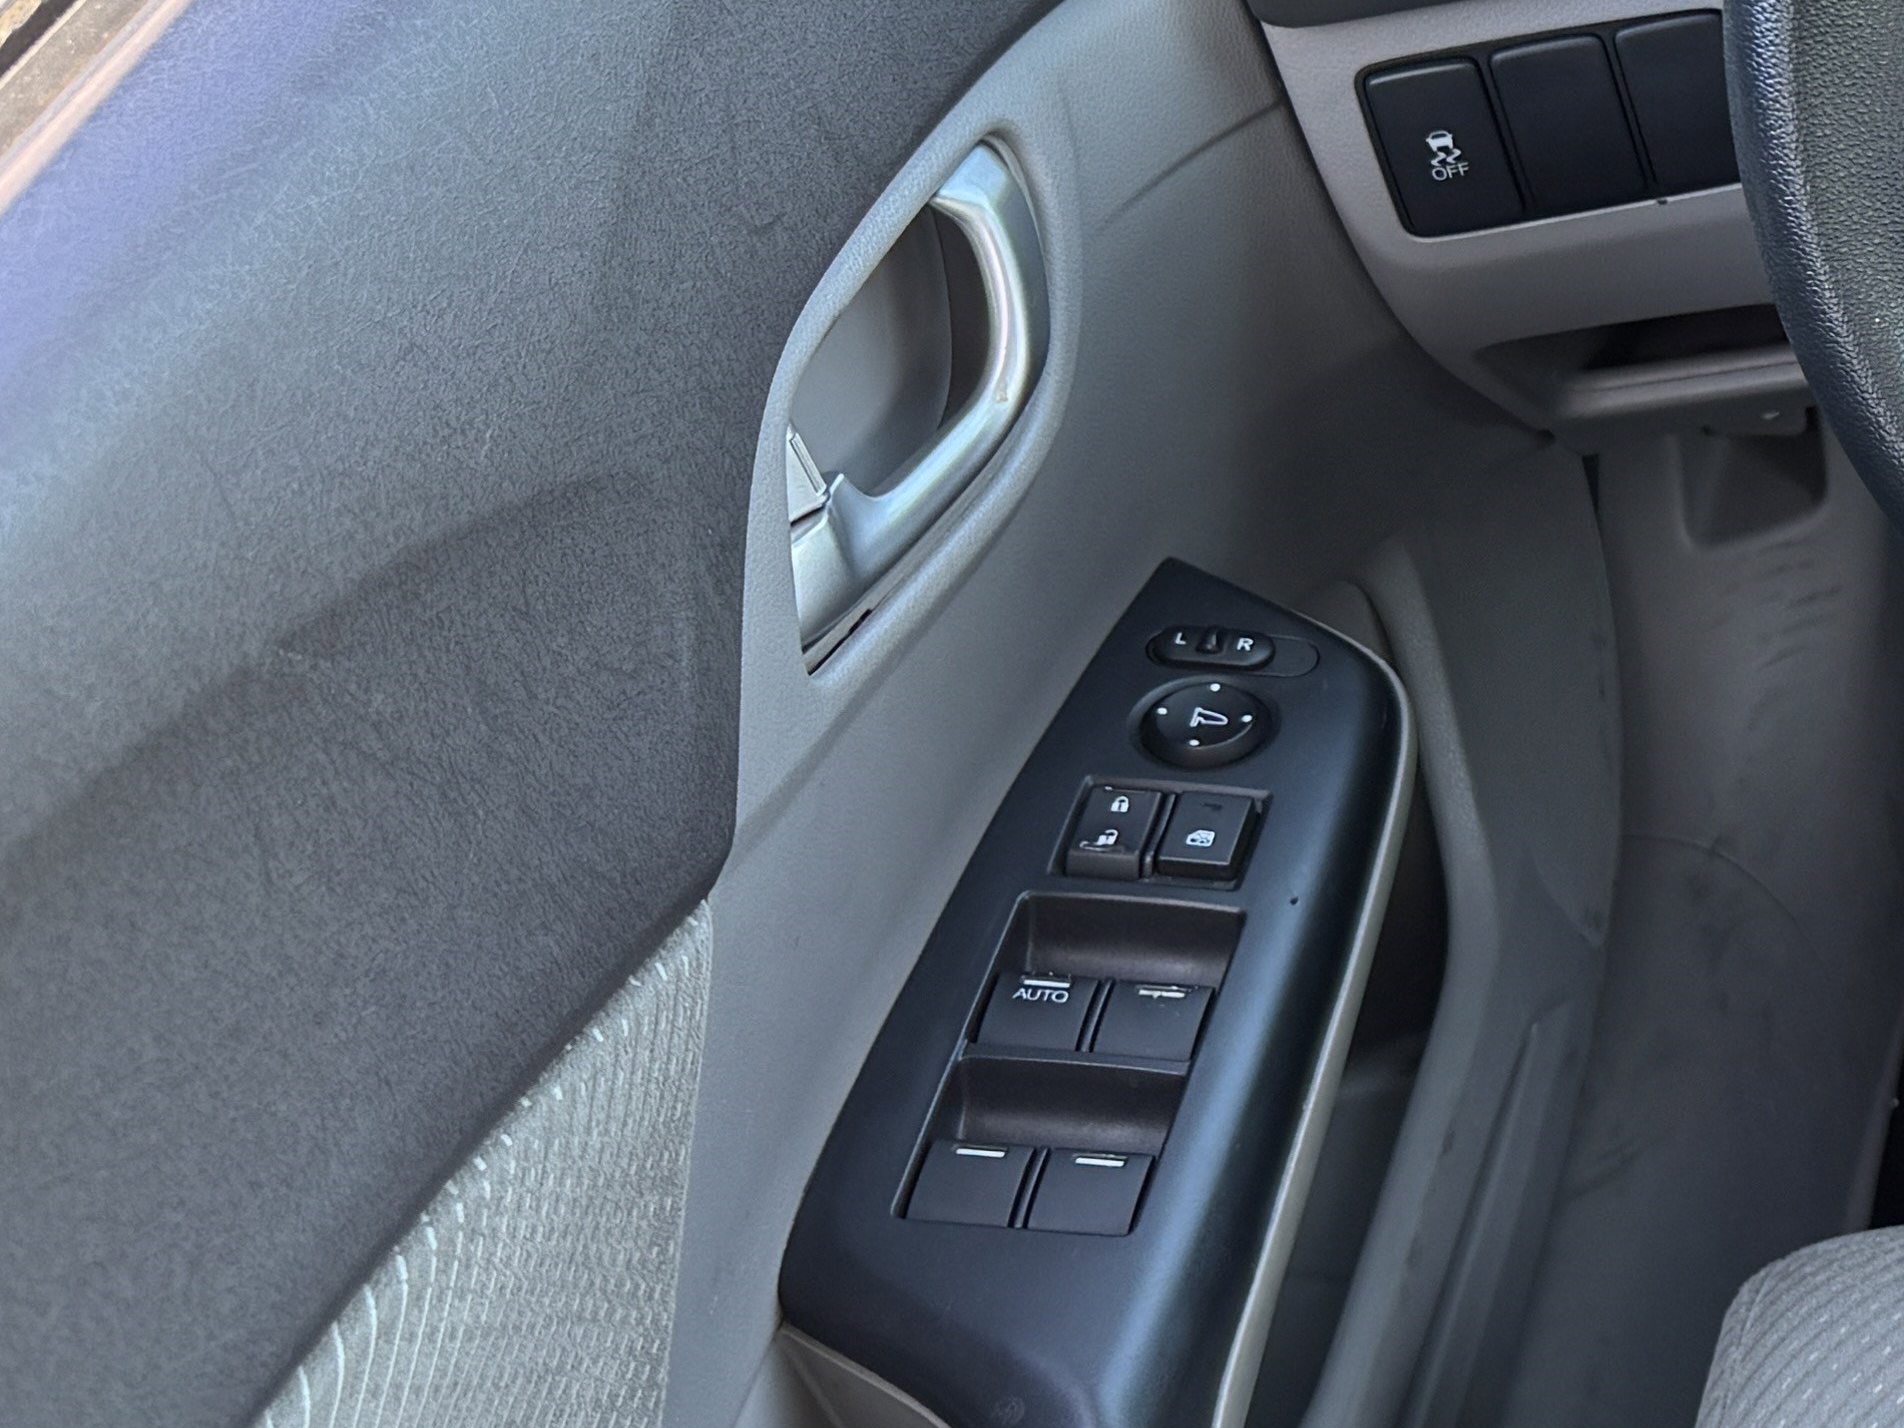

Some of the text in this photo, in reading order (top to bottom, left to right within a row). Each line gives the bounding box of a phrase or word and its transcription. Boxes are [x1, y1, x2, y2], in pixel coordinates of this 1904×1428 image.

[1431, 161, 1470, 181] OFF
[1175, 631, 1254, 652] L R
[1012, 986, 1069, 1004] AUTO
